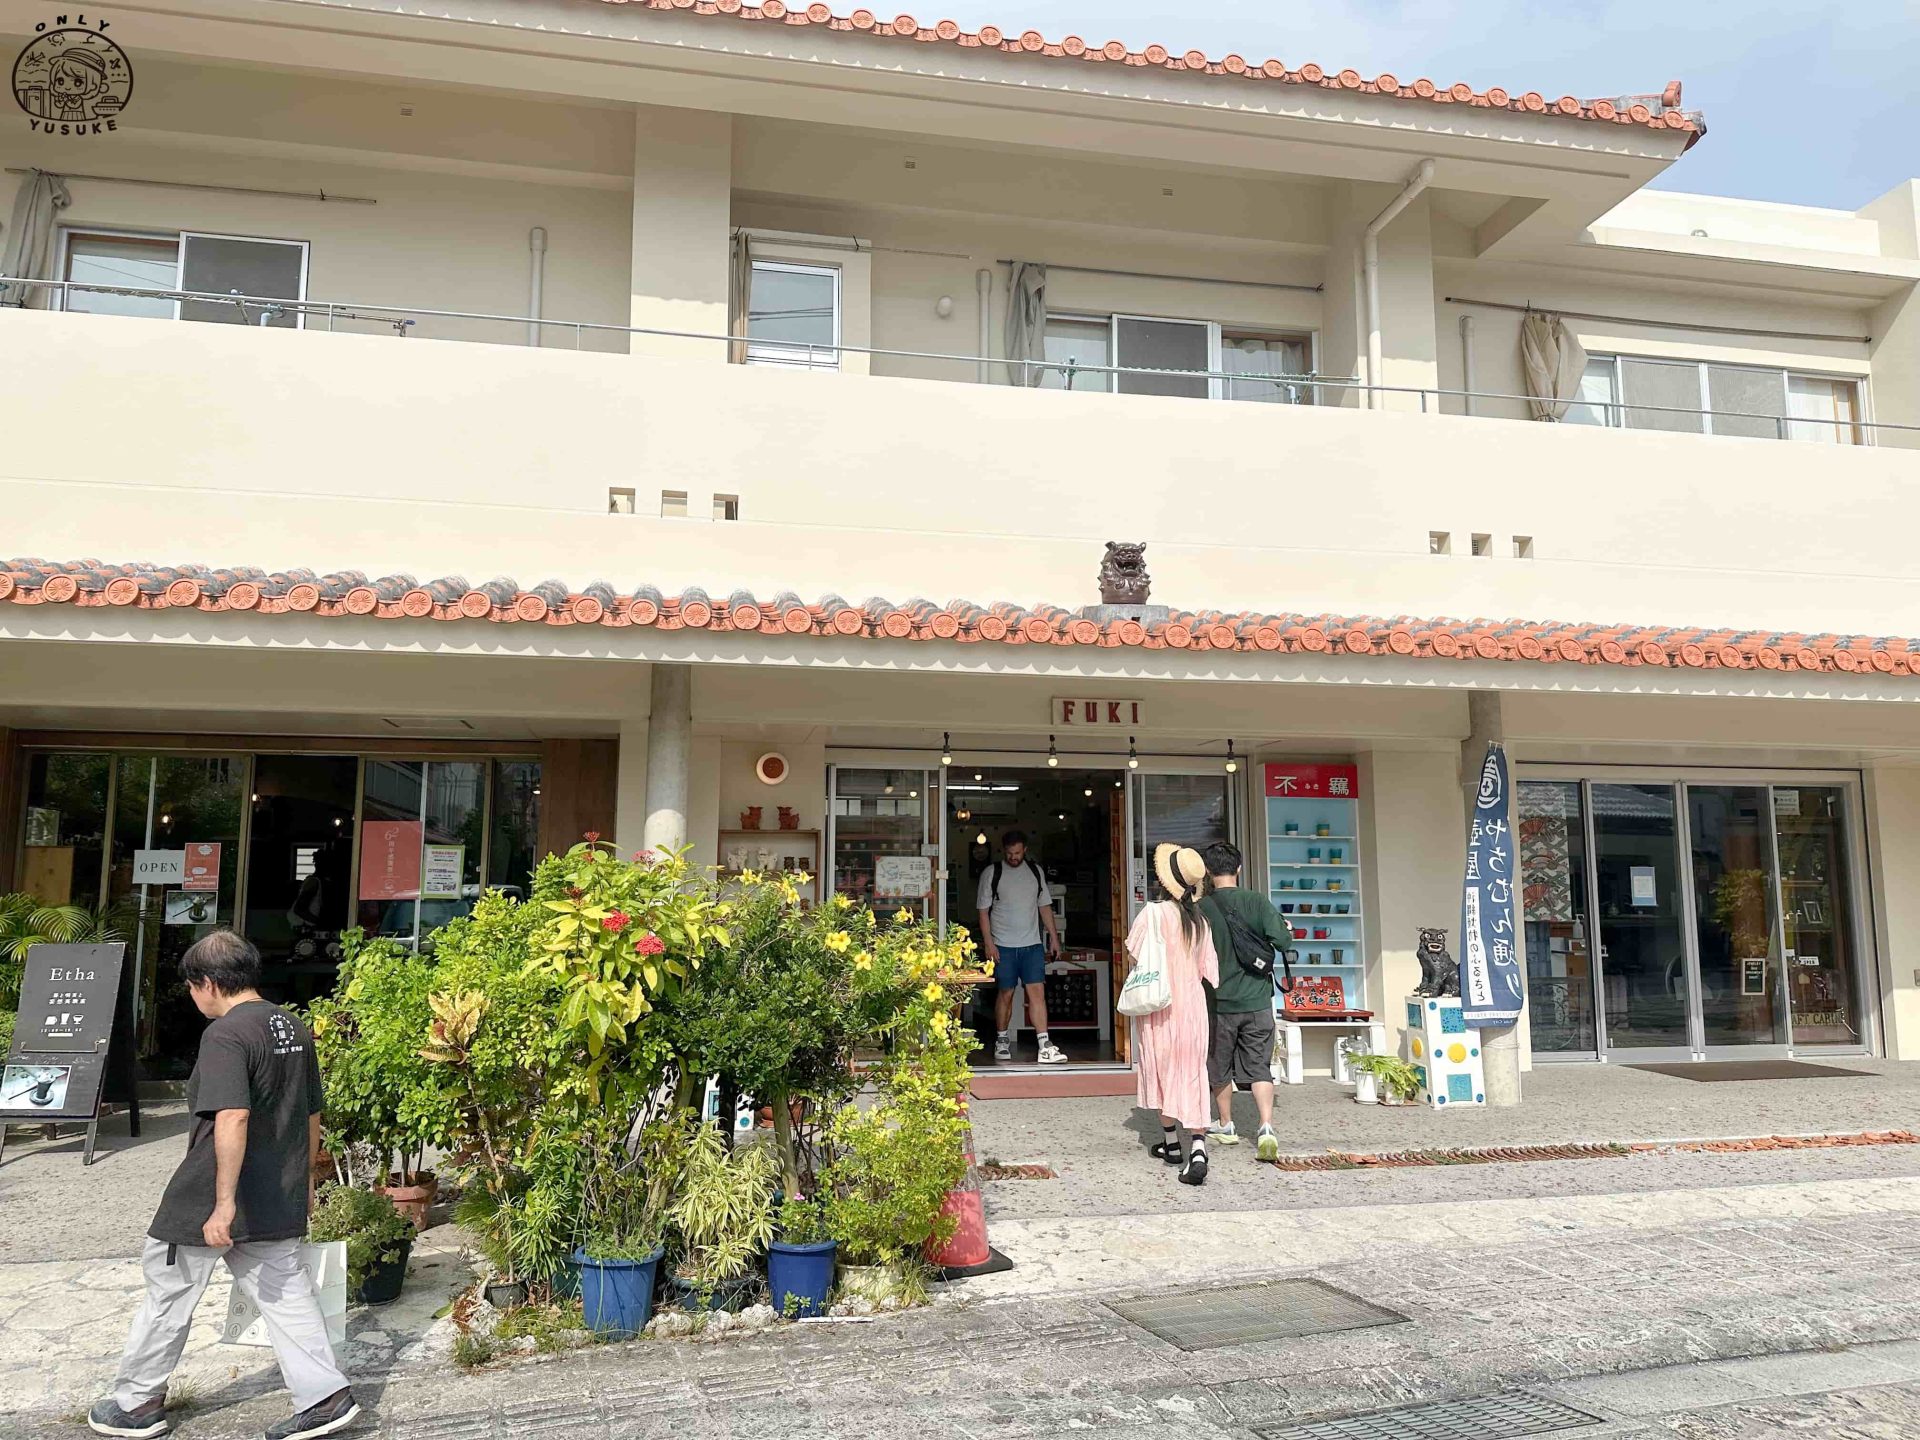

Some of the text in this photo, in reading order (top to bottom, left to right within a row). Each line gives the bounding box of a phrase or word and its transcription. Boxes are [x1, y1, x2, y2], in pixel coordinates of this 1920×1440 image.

[1063, 701, 1138, 723] FUKI
[1274, 776, 1297, 794] 不
[139, 862, 178, 873] OPEN
[49, 967, 95, 981] Etha
[1791, 1013, 1809, 1025] AFT
